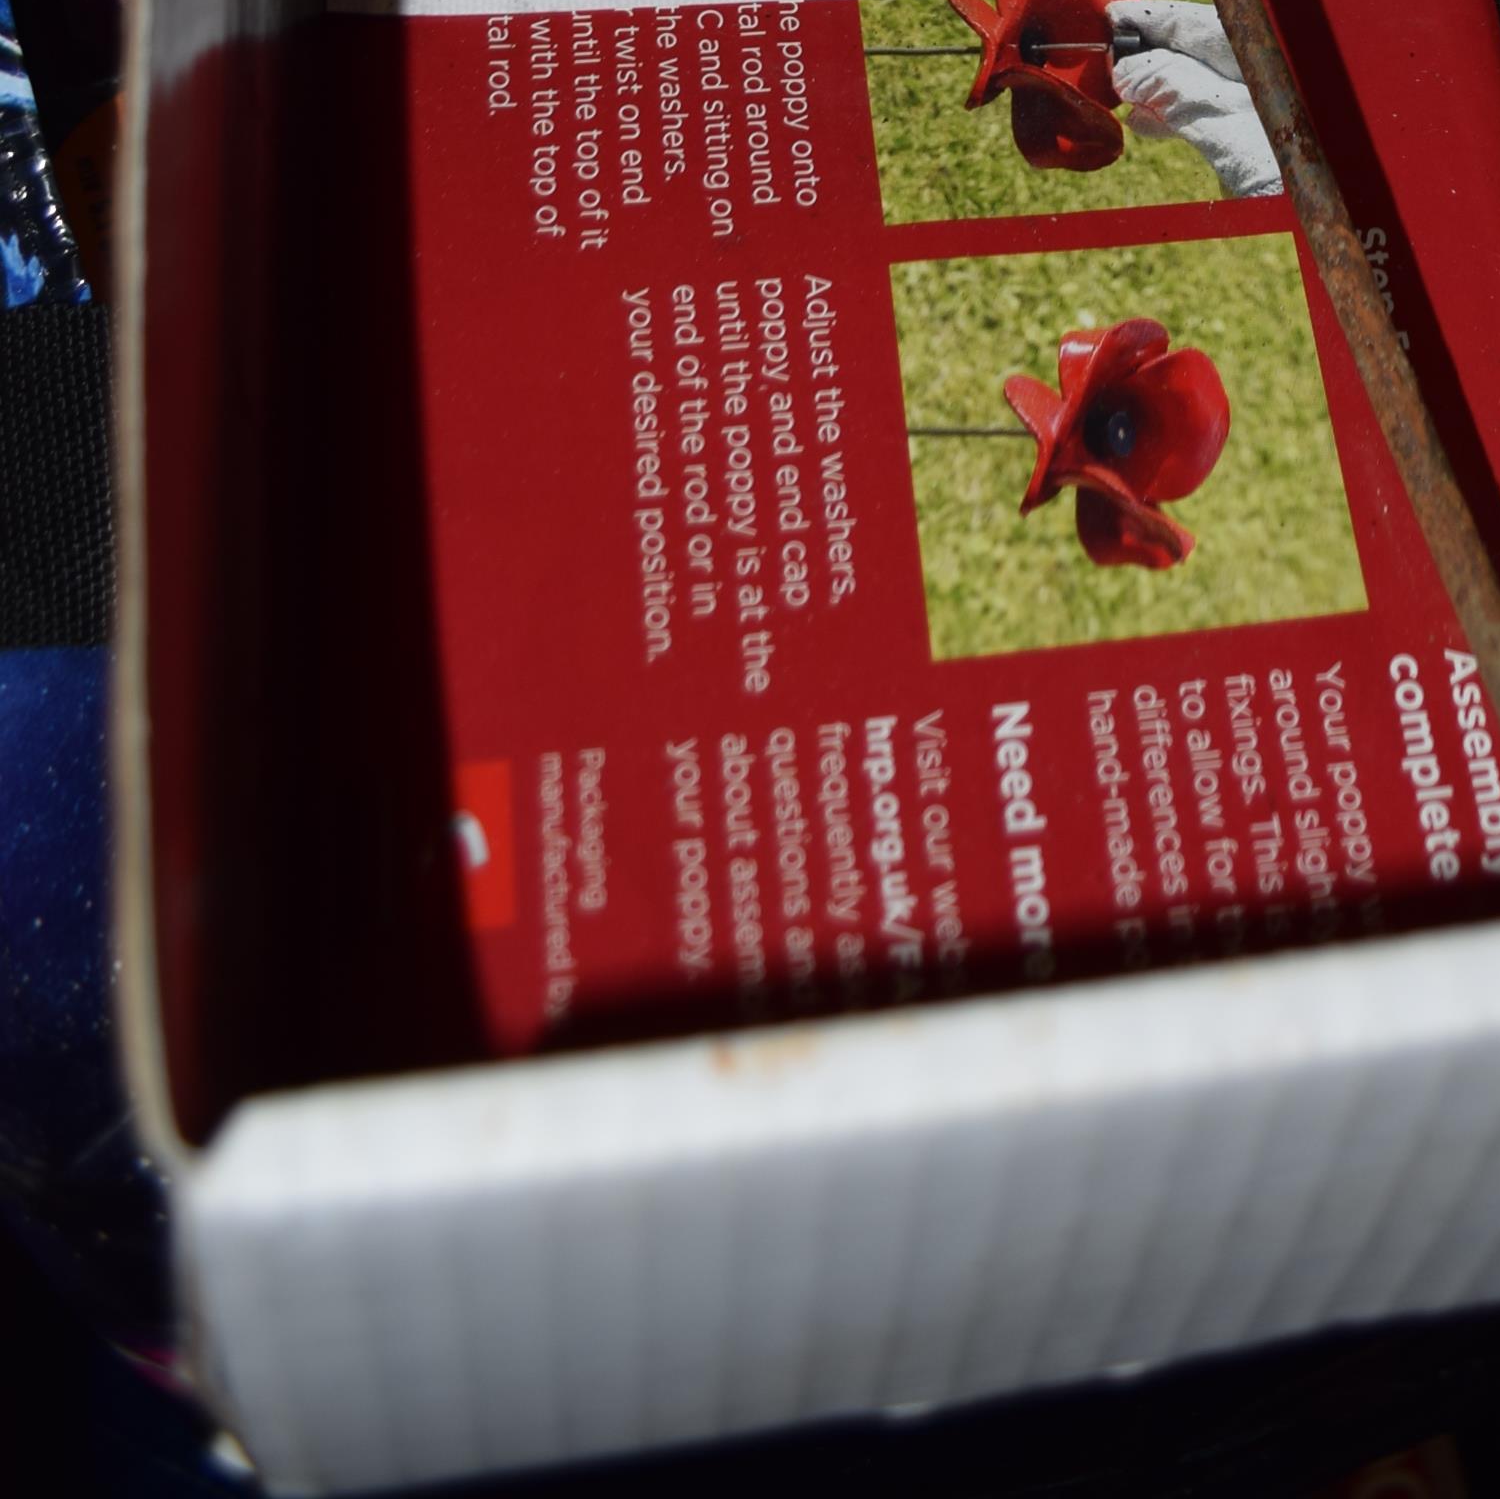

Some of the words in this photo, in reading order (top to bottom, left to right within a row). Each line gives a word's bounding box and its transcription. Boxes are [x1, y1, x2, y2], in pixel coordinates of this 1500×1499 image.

[530, 18, 560, 80] with
[655, 4, 684, 49] the
[697, 9, 724, 30] C
[737, 1, 766, 38] tal
[488, 58, 519, 116] rod.
[614, 24, 644, 96] twist
[700, 39, 730, 91] and
[741, 47, 771, 95] rod
[777, 40, 810, 130] poppy
[532, 88, 560, 136] the
[574, 73, 603, 121] the
[618, 105, 640, 141] on
[659, 57, 690, 182] washers.
[529, 144, 561, 196] top
[573, 128, 602, 181] top
[621, 150, 652, 206] end
[703, 100, 734, 189] sitting
[746, 103, 782, 206] around
[792, 141, 822, 208] onto
[534, 204, 567, 239] of
[578, 189, 610, 221] of
[710, 198, 735, 237] on
[580, 228, 609, 252] it
[623, 286, 654, 362] your
[672, 284, 706, 346] end
[716, 280, 750, 353] until
[804, 273, 840, 379] Adjust
[675, 355, 710, 389] of
[720, 360, 753, 416] the
[632, 371, 670, 498] desired
[679, 397, 712, 456] the
[769, 391, 804, 455] and
[814, 386, 845, 445] the
[684, 464, 718, 525] rod
[721, 424, 758, 536] poppy
[775, 463, 811, 532] end
[634, 508, 677, 664] position.
[687, 534, 715, 573] or
[735, 546, 767, 576] is
[779, 540, 811, 608] cap
[690, 581, 724, 618] in
[737, 586, 771, 622] at
[741, 630, 775, 694] the
[1178, 677, 1208, 720] to
[1315, 661, 1352, 752] Your
[913, 707, 952, 798] Visit
[991, 700, 1048, 835] Need
[1269, 667, 1321, 802] around
[1389, 653, 1462, 883] complete
[665, 736, 704, 830] your
[719, 732, 761, 852] about
[1087, 688, 1147, 909] hand-made
[1133, 683, 1190, 897] differences
[1186, 728, 1224, 830] allow
[1224, 672, 1266, 807] fixings.
[1250, 811, 1288, 895] This
[577, 747, 611, 913] Packaging
[766, 726, 813, 920] questions
[817, 719, 868, 923] frequently
[921, 803, 956, 873] our
[1326, 760, 1378, 885] poppy
[539, 751, 577, 972] manufactured
[1204, 836, 1239, 897] for
[671, 837, 714, 982] poppy.
[1009, 844, 1057, 980] more
